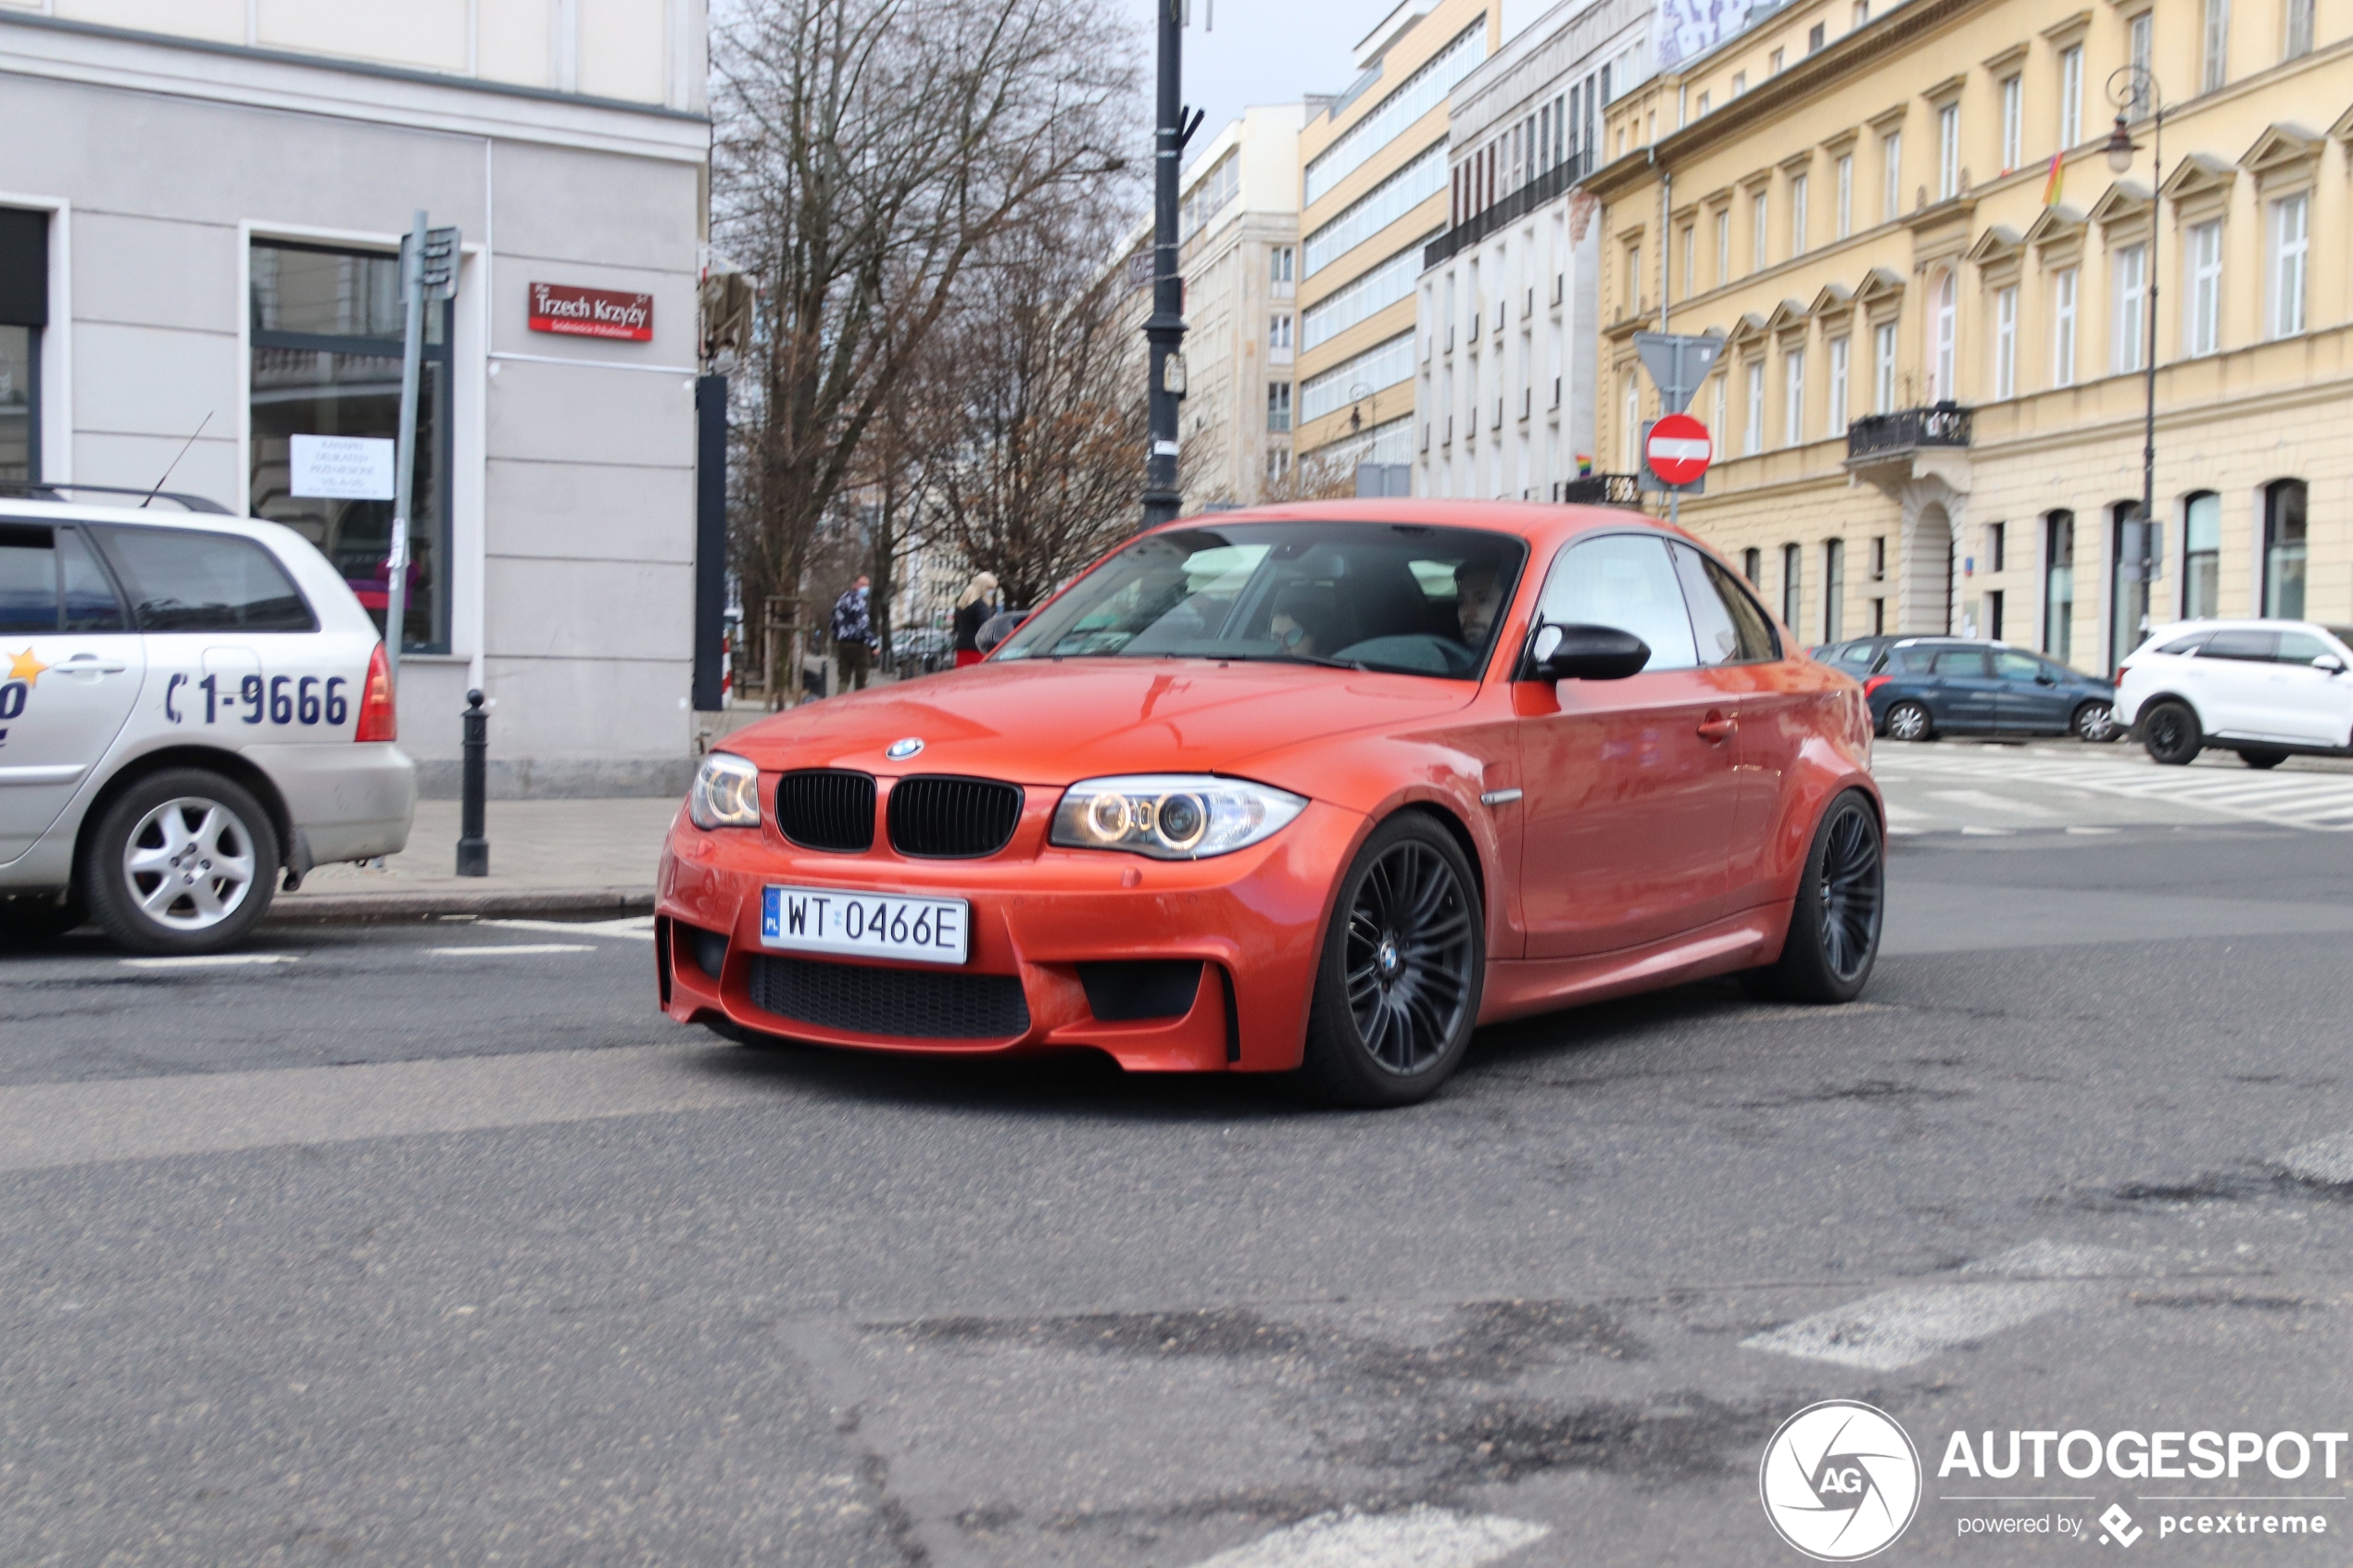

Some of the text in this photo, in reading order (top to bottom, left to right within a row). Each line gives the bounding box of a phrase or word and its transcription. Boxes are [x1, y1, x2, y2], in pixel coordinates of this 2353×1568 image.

[535, 293, 648, 330] Trzech Krzyży
[199, 673, 347, 725] 1-9666
[766, 916, 779, 931] PL
[788, 895, 957, 948] WT 0466E
